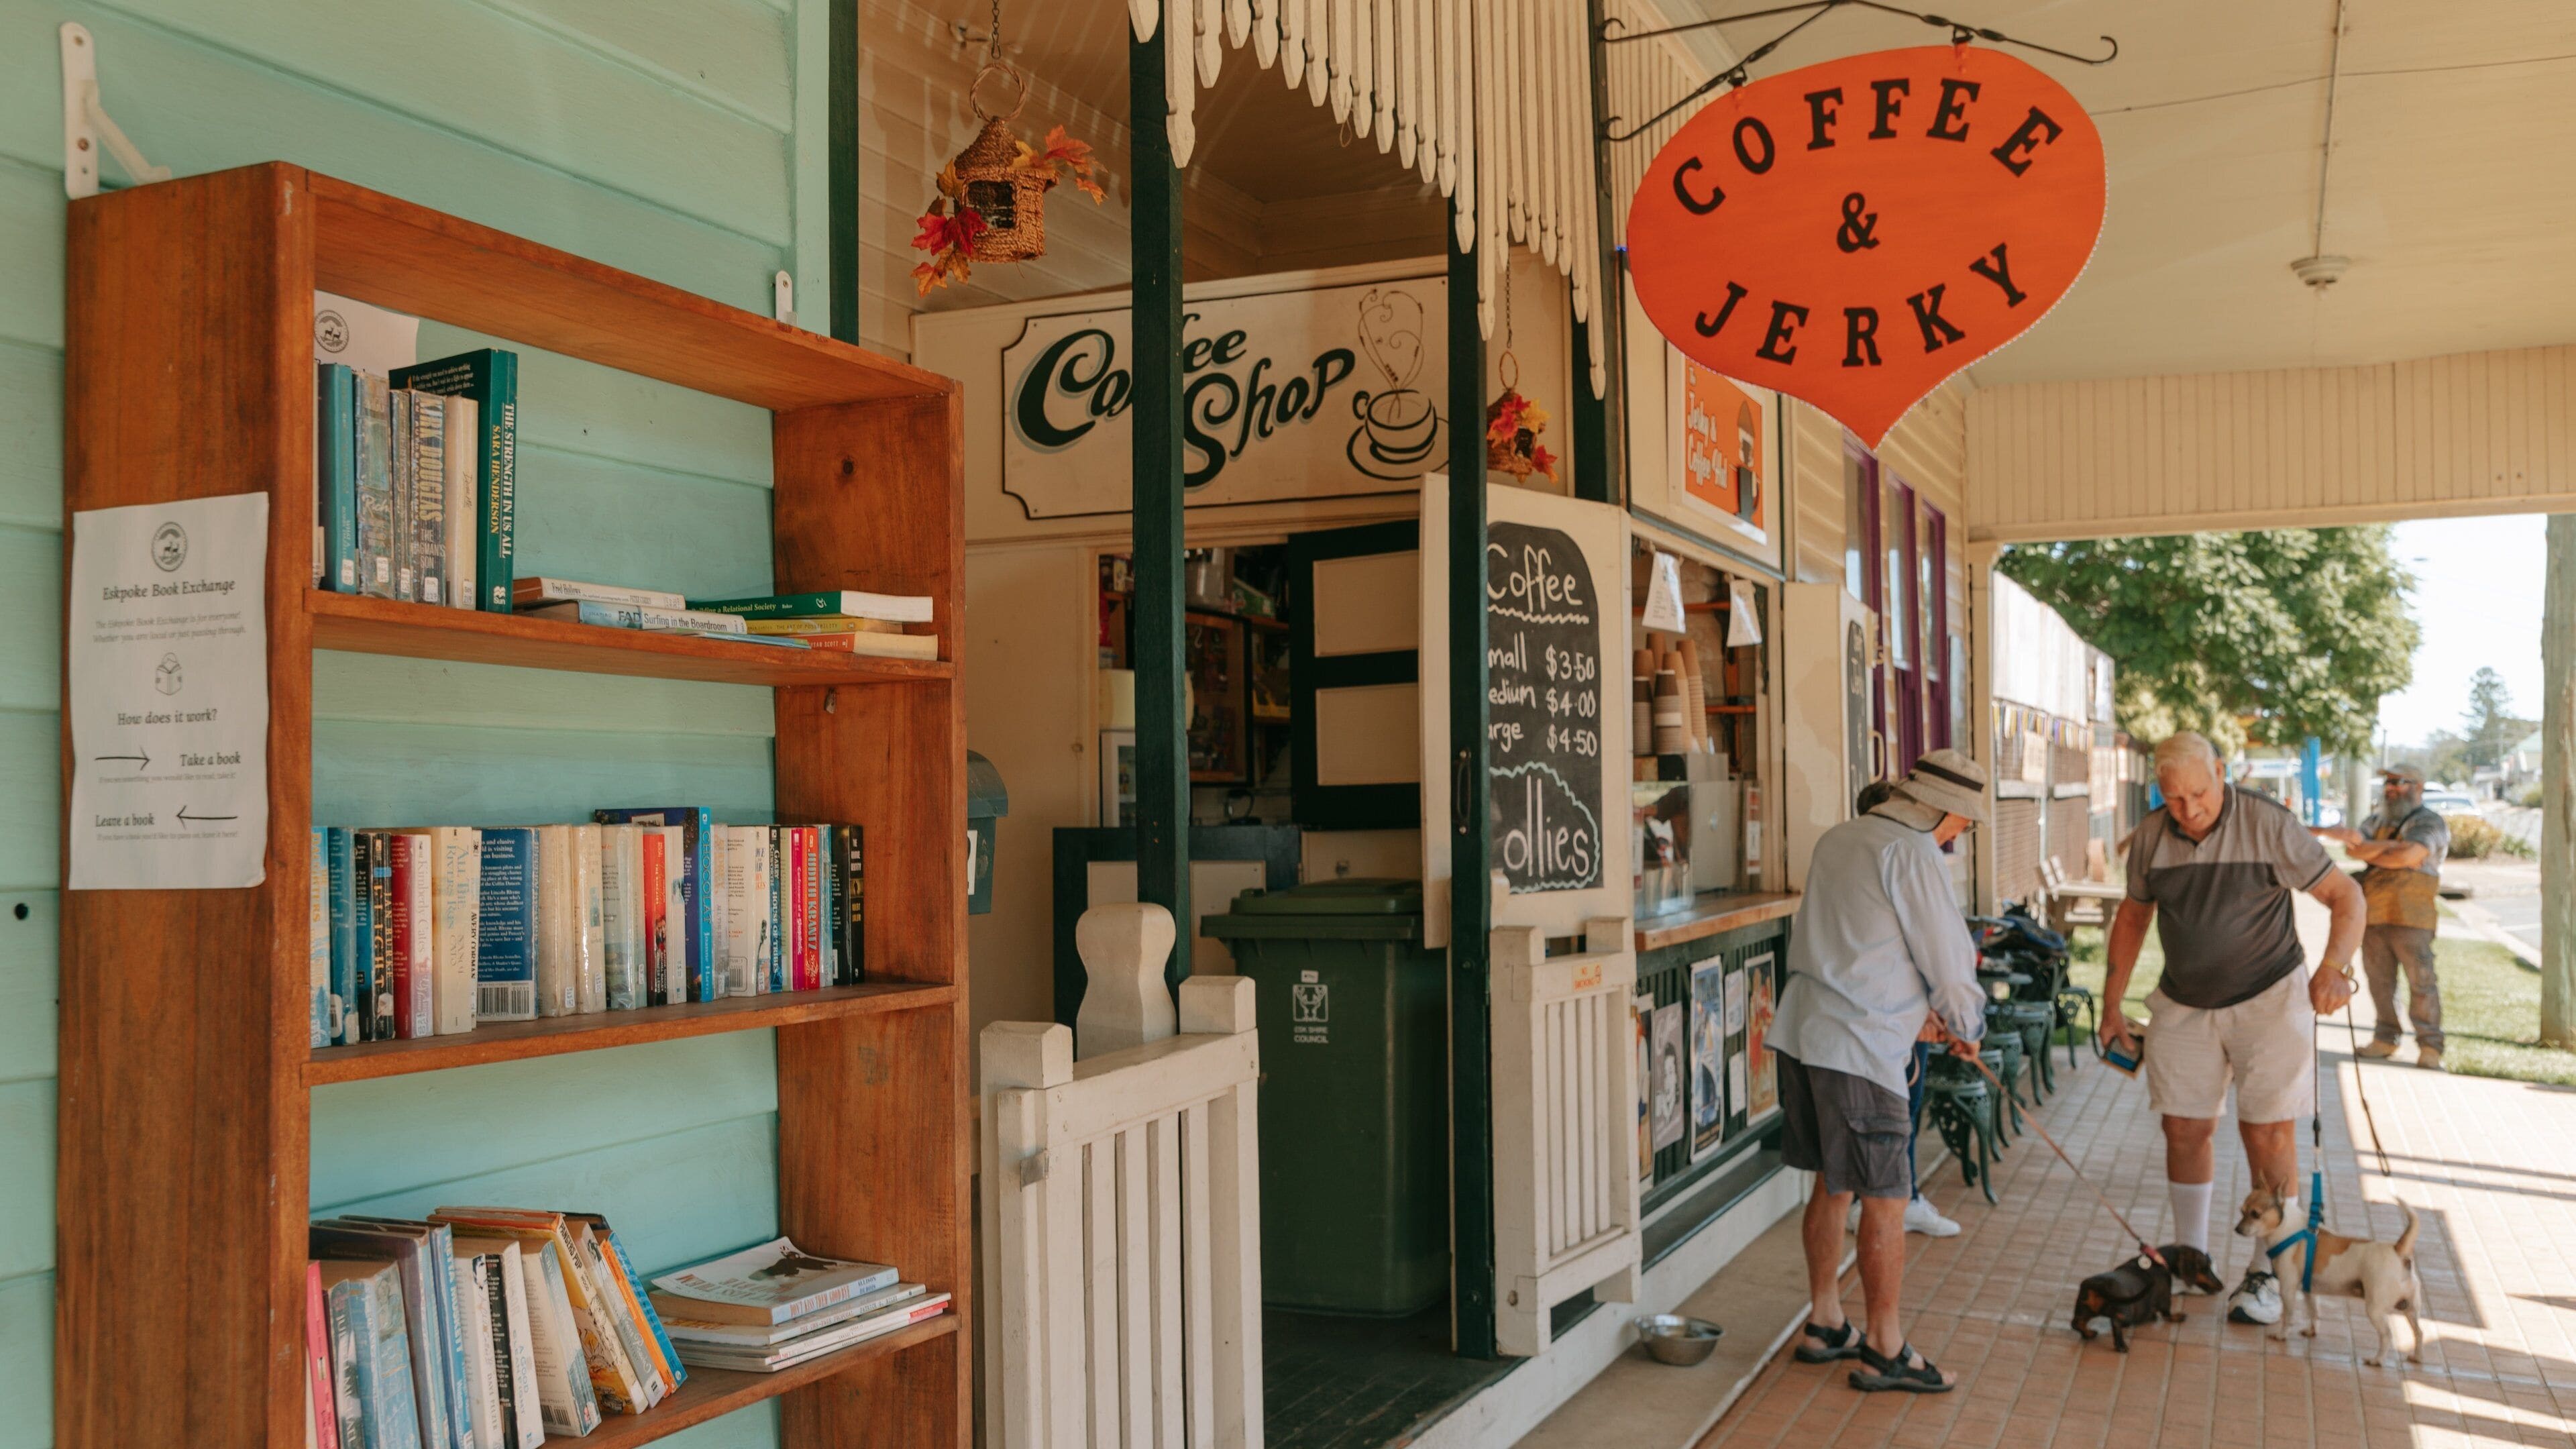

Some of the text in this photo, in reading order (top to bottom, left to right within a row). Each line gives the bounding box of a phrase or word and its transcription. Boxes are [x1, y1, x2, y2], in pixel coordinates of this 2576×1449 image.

[1673, 78, 2063, 215] COFFEE
[1837, 193, 1880, 253] &
[1695, 243, 2027, 366] JERKY
[1012, 313, 1246, 452] Coee
[419, 400, 443, 523] KIRK DOUGLAS
[490, 425, 501, 535] SARA HENDERSON
[501, 404, 514, 558] THE STRENGTH IN US ALL
[152, 582, 179, 597] Book
[182, 579, 235, 596] Exchange
[551, 582, 564, 594] Fred
[1487, 543, 1582, 613] Coffee
[618, 610, 641, 625] FAD
[643, 613, 669, 629] Surfing
[671, 616, 678, 627] in
[678, 616, 690, 628] the
[691, 616, 727, 632] Boardroom
[722, 603, 753, 613] Relational
[754, 602, 777, 612] Society
[1489, 631, 1527, 673] mall
[1489, 678, 1536, 710] edium
[117, 708, 218, 726] How does it work?
[1488, 722, 1524, 753] rge
[179, 751, 241, 767] Take a book
[123, 818, 129, 827] a
[132, 813, 155, 826] book
[1503, 774, 1591, 878] ollies
[701, 830, 712, 924] CHOCOLAT
[417, 859, 429, 957] Kimberly Cates
[808, 849, 816, 951] JUDITH KRANTZ
[772, 925, 778, 937] OF
[572, 1252, 583, 1270] PUP
[520, 1356, 529, 1393] GOOD
